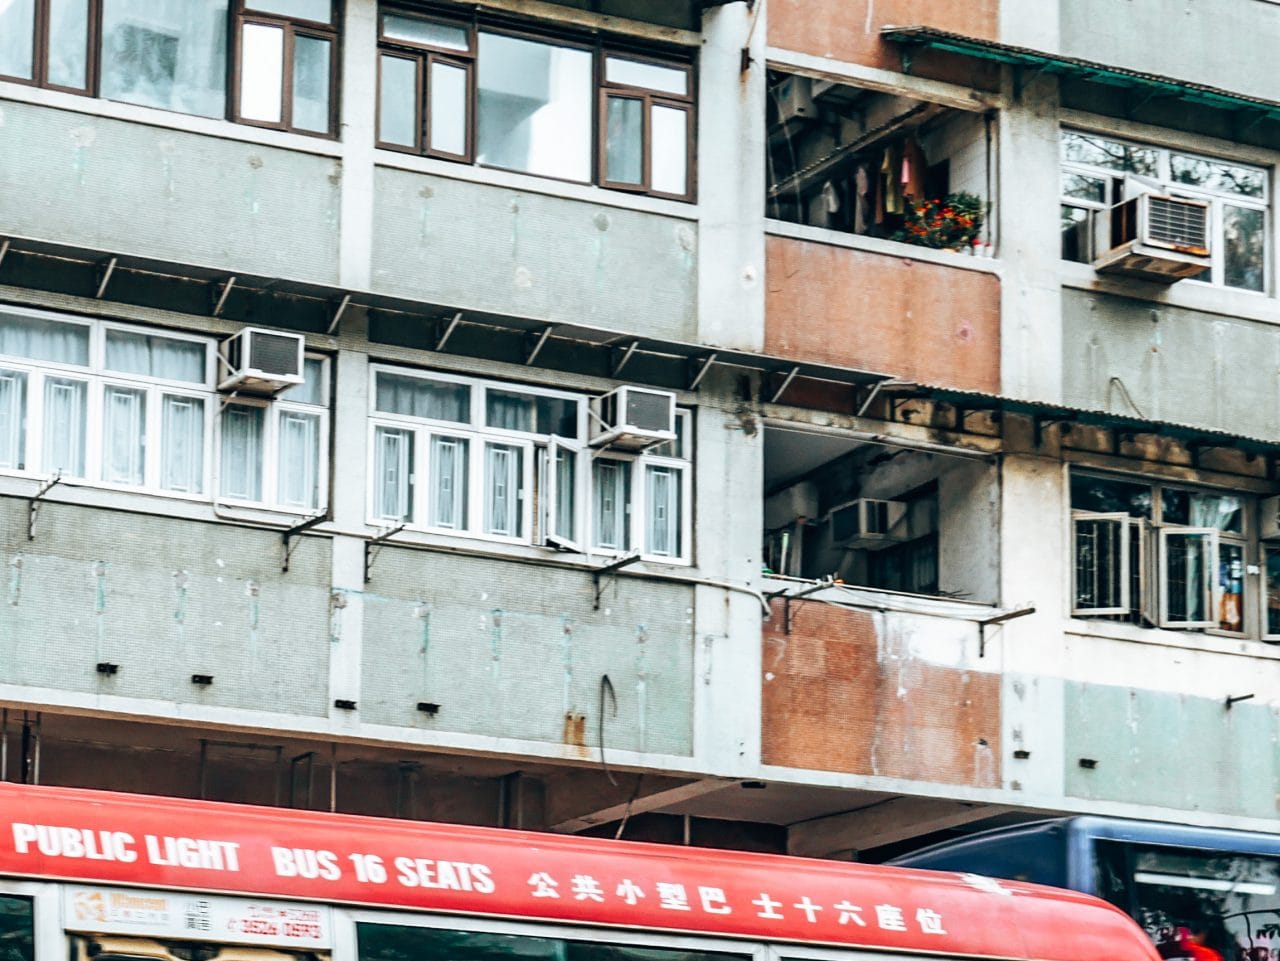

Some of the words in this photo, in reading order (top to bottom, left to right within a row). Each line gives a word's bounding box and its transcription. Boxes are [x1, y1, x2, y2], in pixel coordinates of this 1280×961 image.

[11, 822, 138, 863] PUBLIC
[144, 834, 241, 872] LIGHT
[272, 846, 340, 881] BUS
[351, 852, 387, 885] 16
[396, 857, 496, 894] SEATS
[527, 871, 948, 936] 公共小型巴士十六座位
